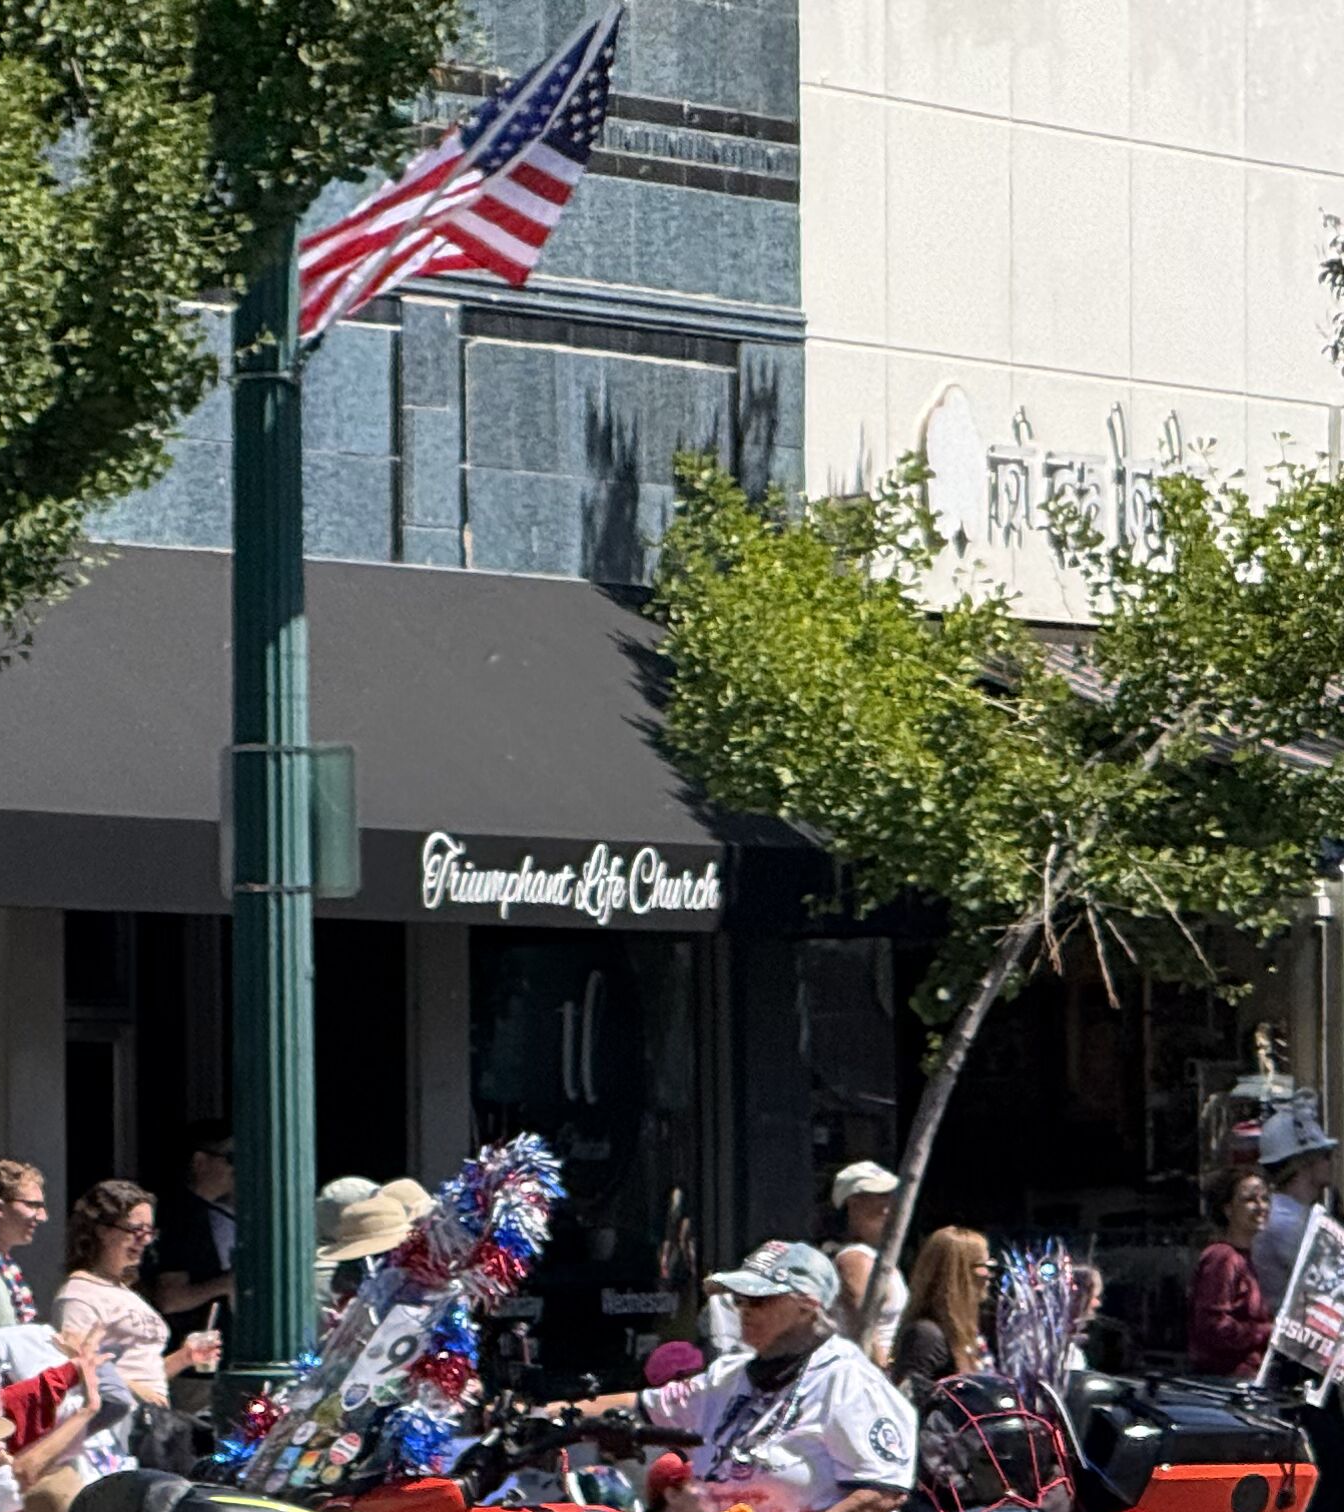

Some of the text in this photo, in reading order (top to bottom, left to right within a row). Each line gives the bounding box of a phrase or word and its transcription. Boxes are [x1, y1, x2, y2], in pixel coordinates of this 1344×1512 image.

[423, 832, 721, 925] Triumphant Life Church
